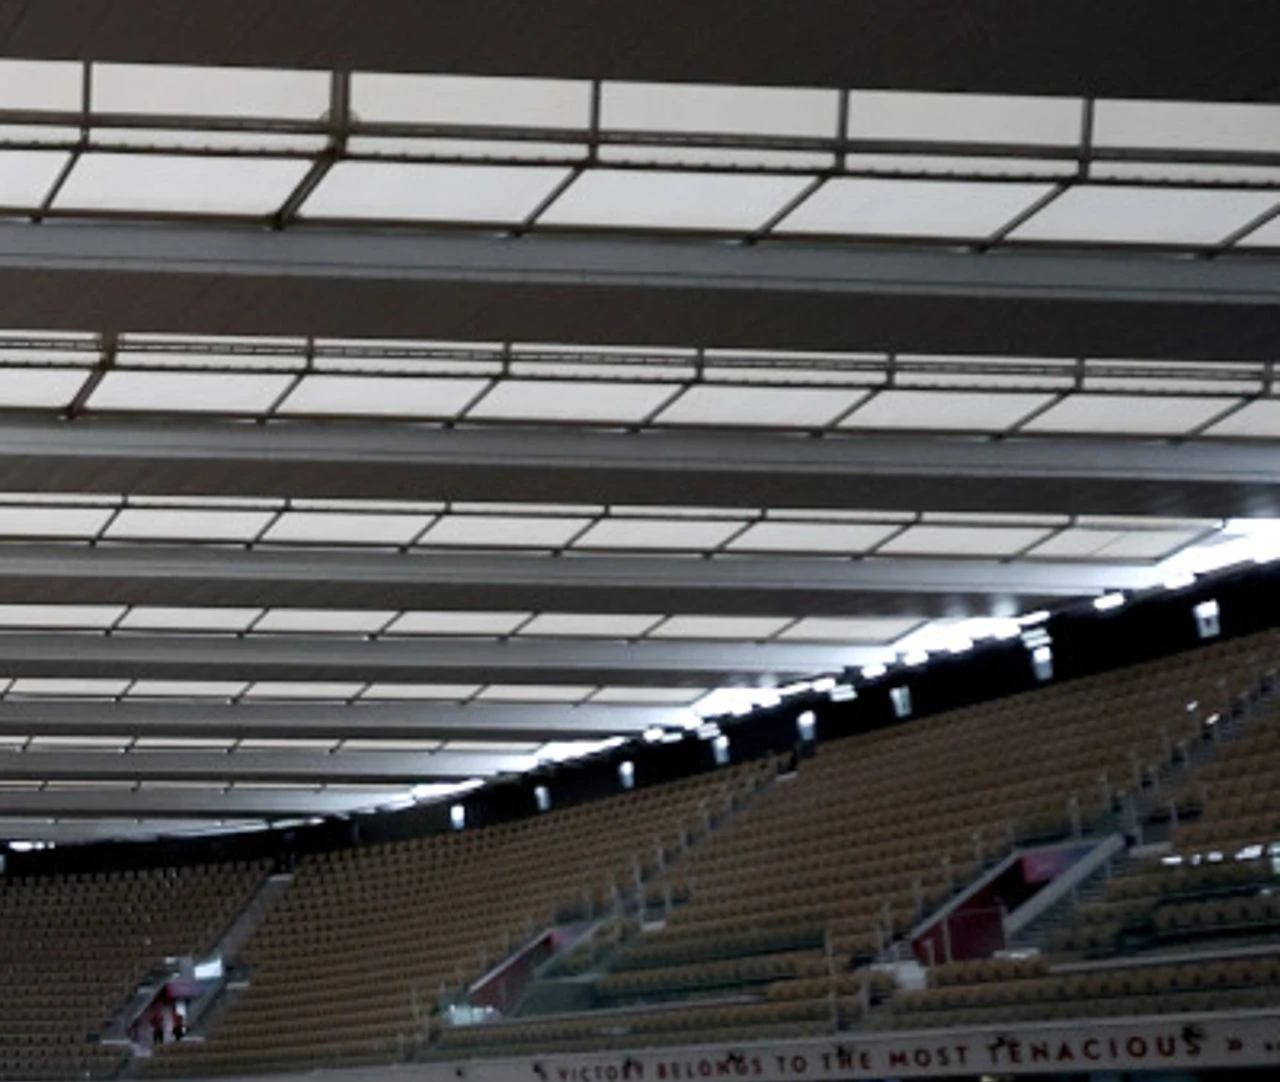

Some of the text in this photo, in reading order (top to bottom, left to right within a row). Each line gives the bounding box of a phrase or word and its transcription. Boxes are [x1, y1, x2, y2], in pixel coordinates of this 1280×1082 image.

[558, 1061, 643, 1082] VICTORY
[657, 1056, 762, 1080] BELONGS
[776, 1055, 807, 1073] TO
[821, 1051, 870, 1070] THE
[889, 1046, 967, 1067] MOST
[986, 1033, 1201, 1064] TENACIOUS
